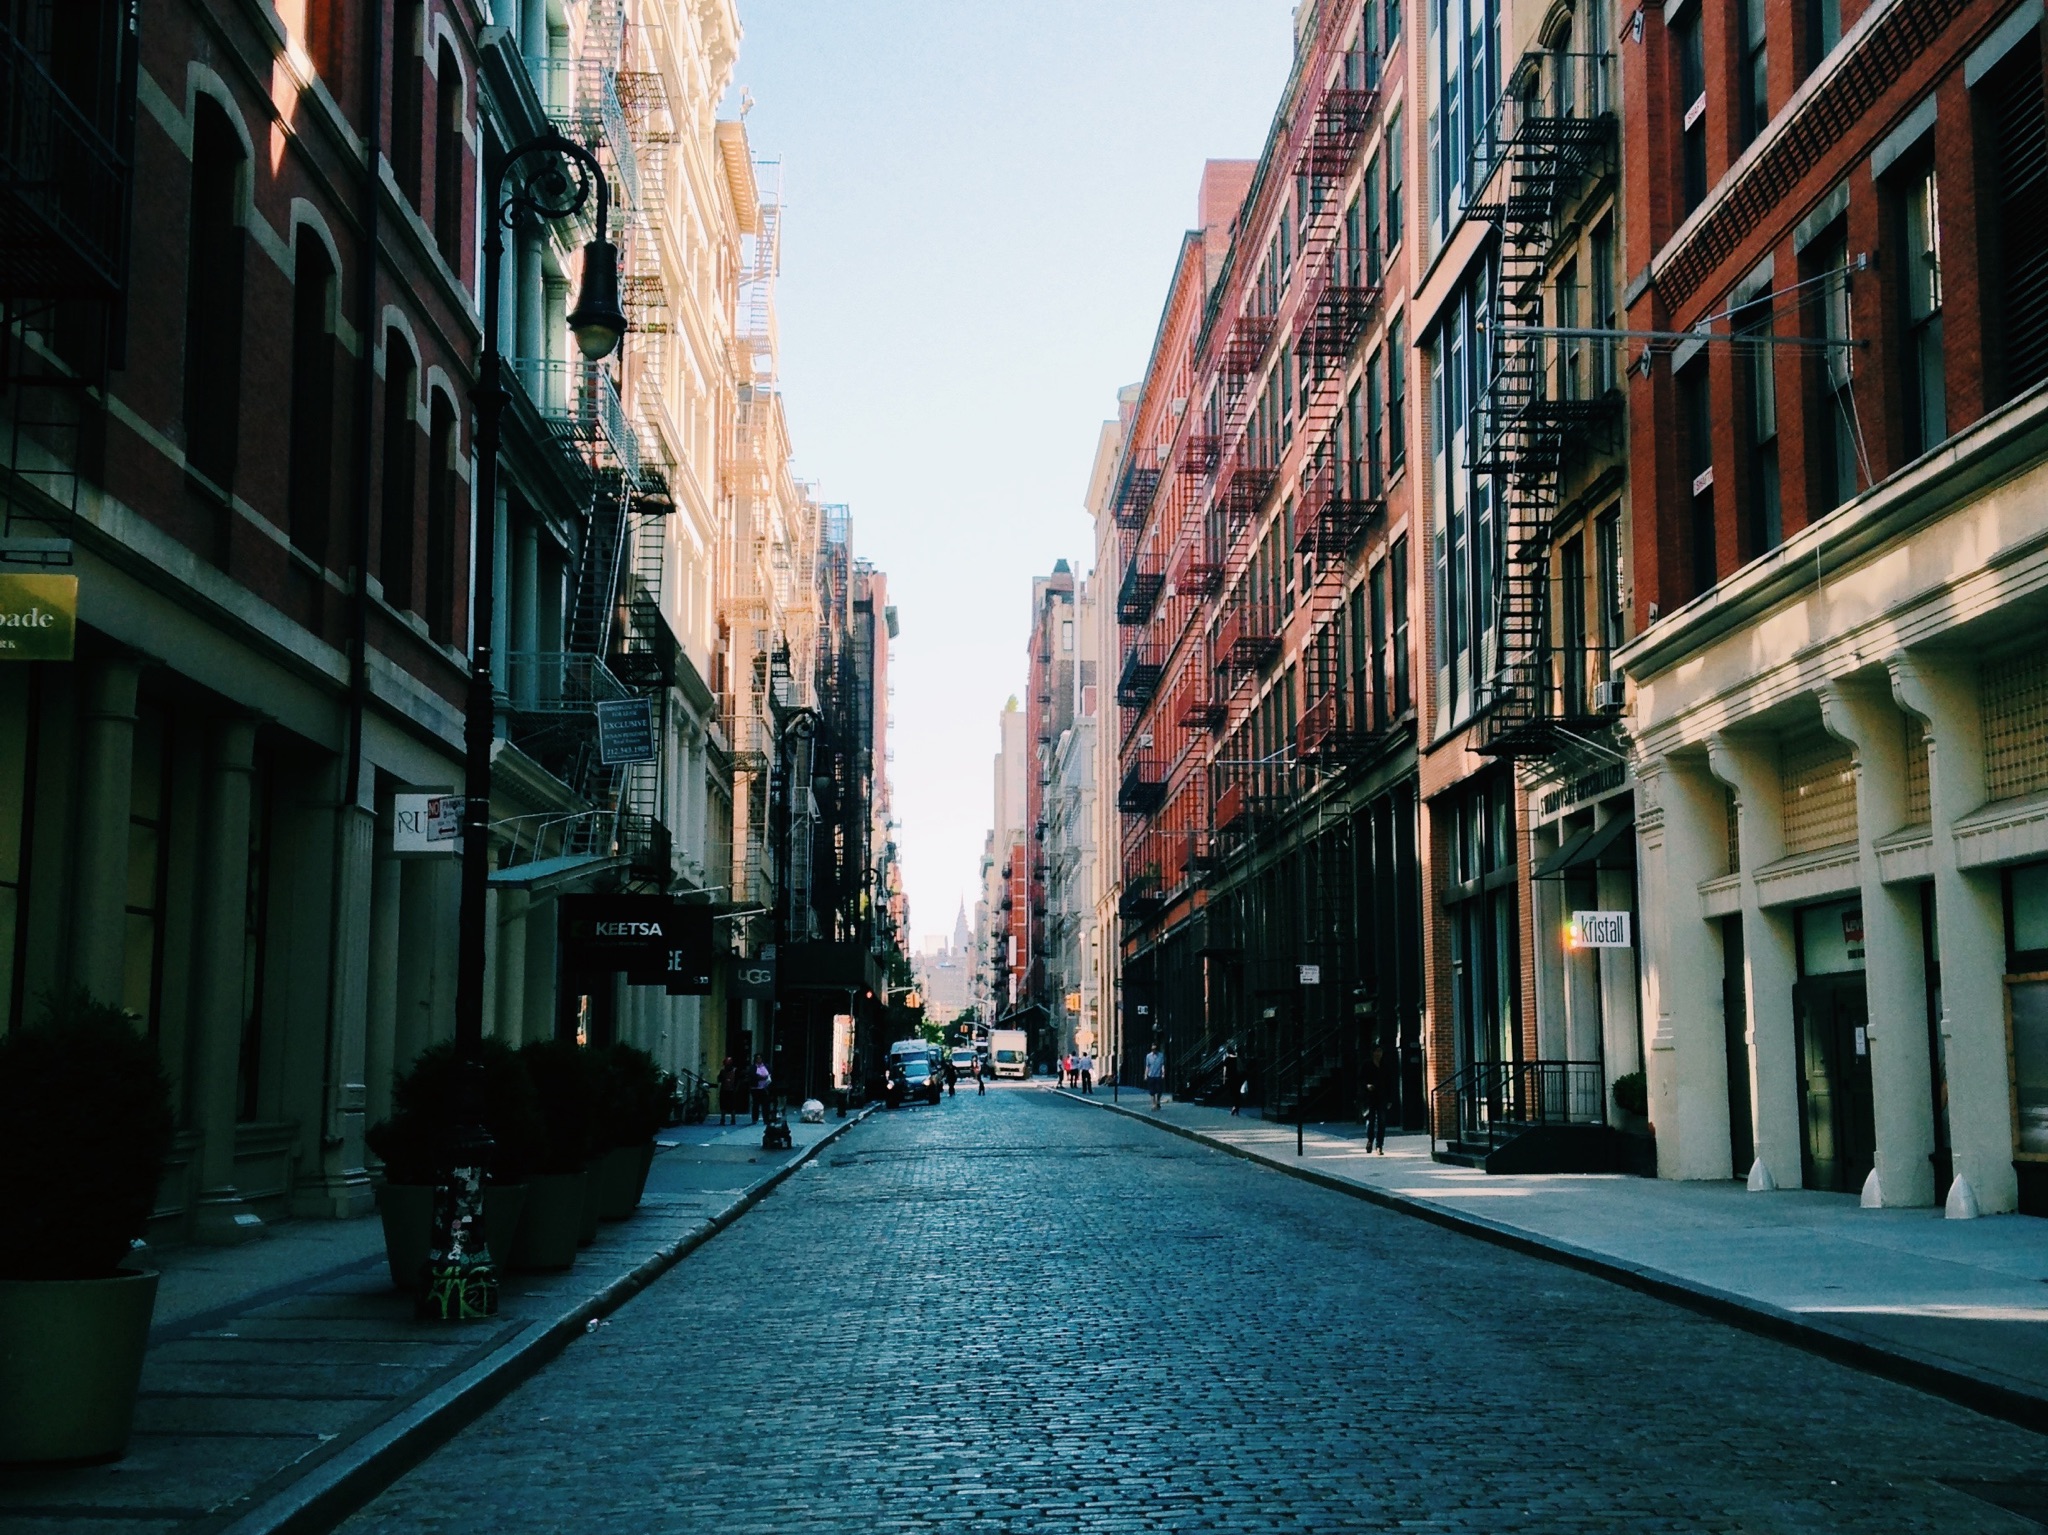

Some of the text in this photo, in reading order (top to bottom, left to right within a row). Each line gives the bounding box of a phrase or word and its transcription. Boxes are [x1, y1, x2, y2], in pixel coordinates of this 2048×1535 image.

[603, 719, 648, 730] EXCLUSIVE
[428, 800, 440, 817] NO
[595, 921, 663, 937] KEETSA
[1581, 915, 1624, 943] kristall
[737, 968, 772, 984] UGG
